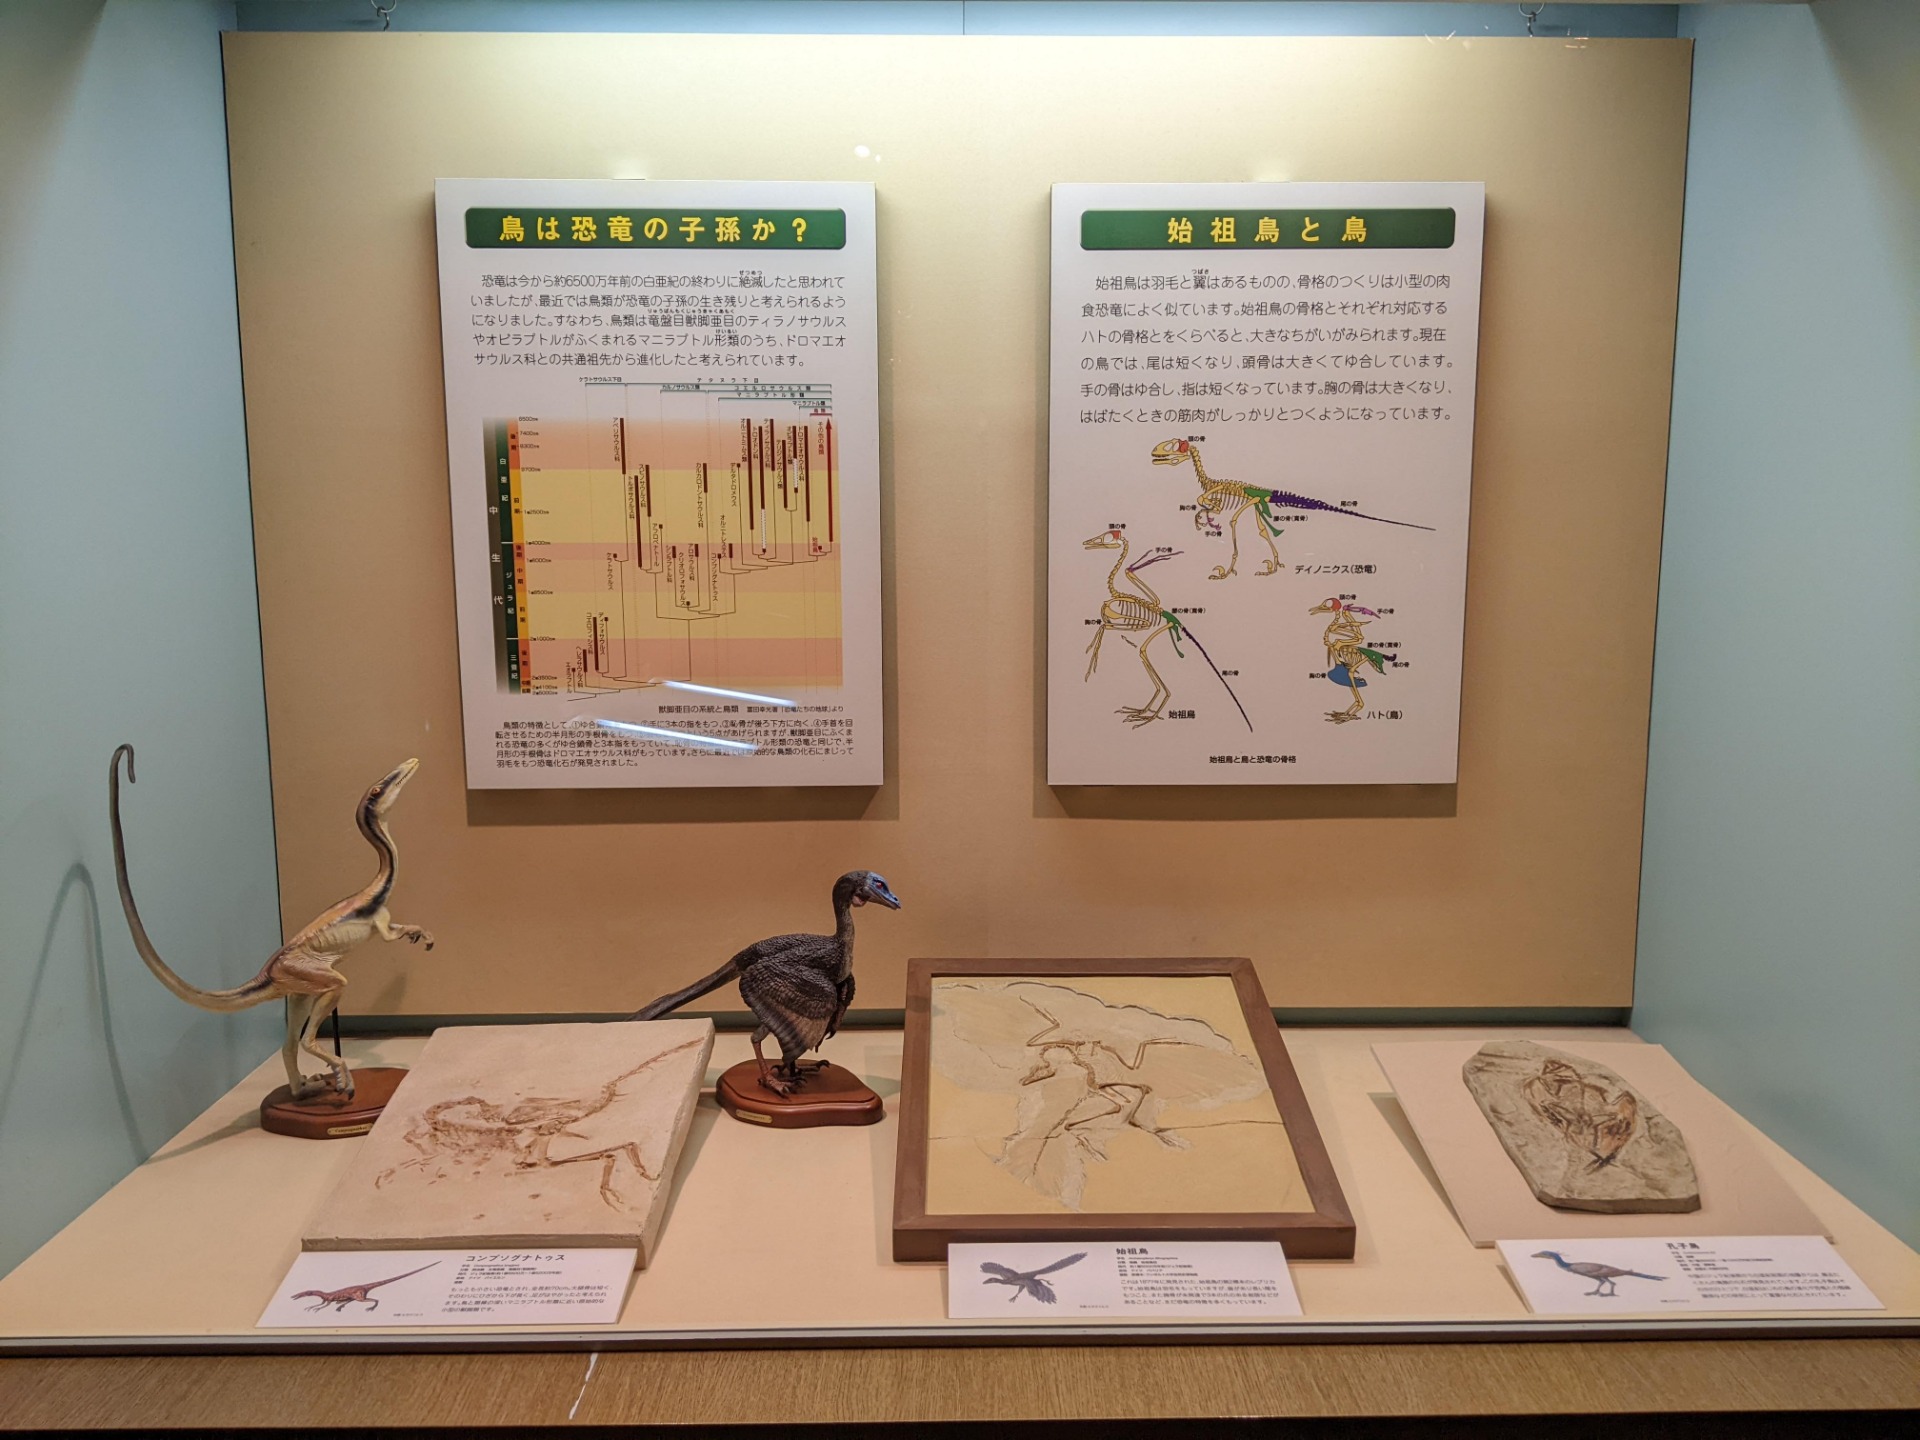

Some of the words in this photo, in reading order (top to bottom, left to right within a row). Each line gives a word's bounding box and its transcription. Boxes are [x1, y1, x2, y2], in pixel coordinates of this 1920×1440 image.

[499, 215, 807, 243] 鳥は恐竜の子孫か？
[1167, 216, 1368, 243] 始祖鳥と鳥
[481, 275, 844, 289] 恐竜は今から約6500万年前の白亜紀の終わりに絶滅したと思われて
[1095, 275, 1450, 291] 始祖鳥は羽毛と翼はあるものの、骨格のつくりは小型の肉
[471, 294, 847, 308] いましたが、最近では鳥類が恐竜の子孫の生き残りと考えられるよう
[1081, 302, 1447, 317] 食恐竜によく似ています。始祖鳥の骨格とそれぞれ対応する
[472, 314, 847, 328] になりました。すなわち、鳥類は竜盤目獣脚亜目のティラノサウルス
[473, 334, 847, 347] やオビラプトルがふくまれるマニラプトル形類のうち、ドロマエオ
[1081, 328, 1446, 344] ハトの骨格とをくらべると、大きなちがいがみられます。現在
[474, 353, 805, 366] サウルス科との共通祖先から進化したと考えられています。
[1081, 354, 1453, 370] の鳥では、尾は短くなり、頭骨は大きくてゆ合しています。
[1080, 381, 1452, 397] 手の骨はゆ合し、指は短くなっています。胸の骨は大きくなり、
[1080, 408, 1450, 423] はばたくときの筋肉がしっかりとつくようになっています。
[658, 705, 739, 714] 獣脚亜目の系統と鳥類
[1168, 710, 1196, 720] 始祖鳥
[1367, 710, 1403, 720] ハト（鳥）
[496, 759, 638, 768] 羽毛をもつ恐竜化石が発見されました。
[1209, 755, 1297, 764] 始祖鳥と鳥と恐竜の骨格
